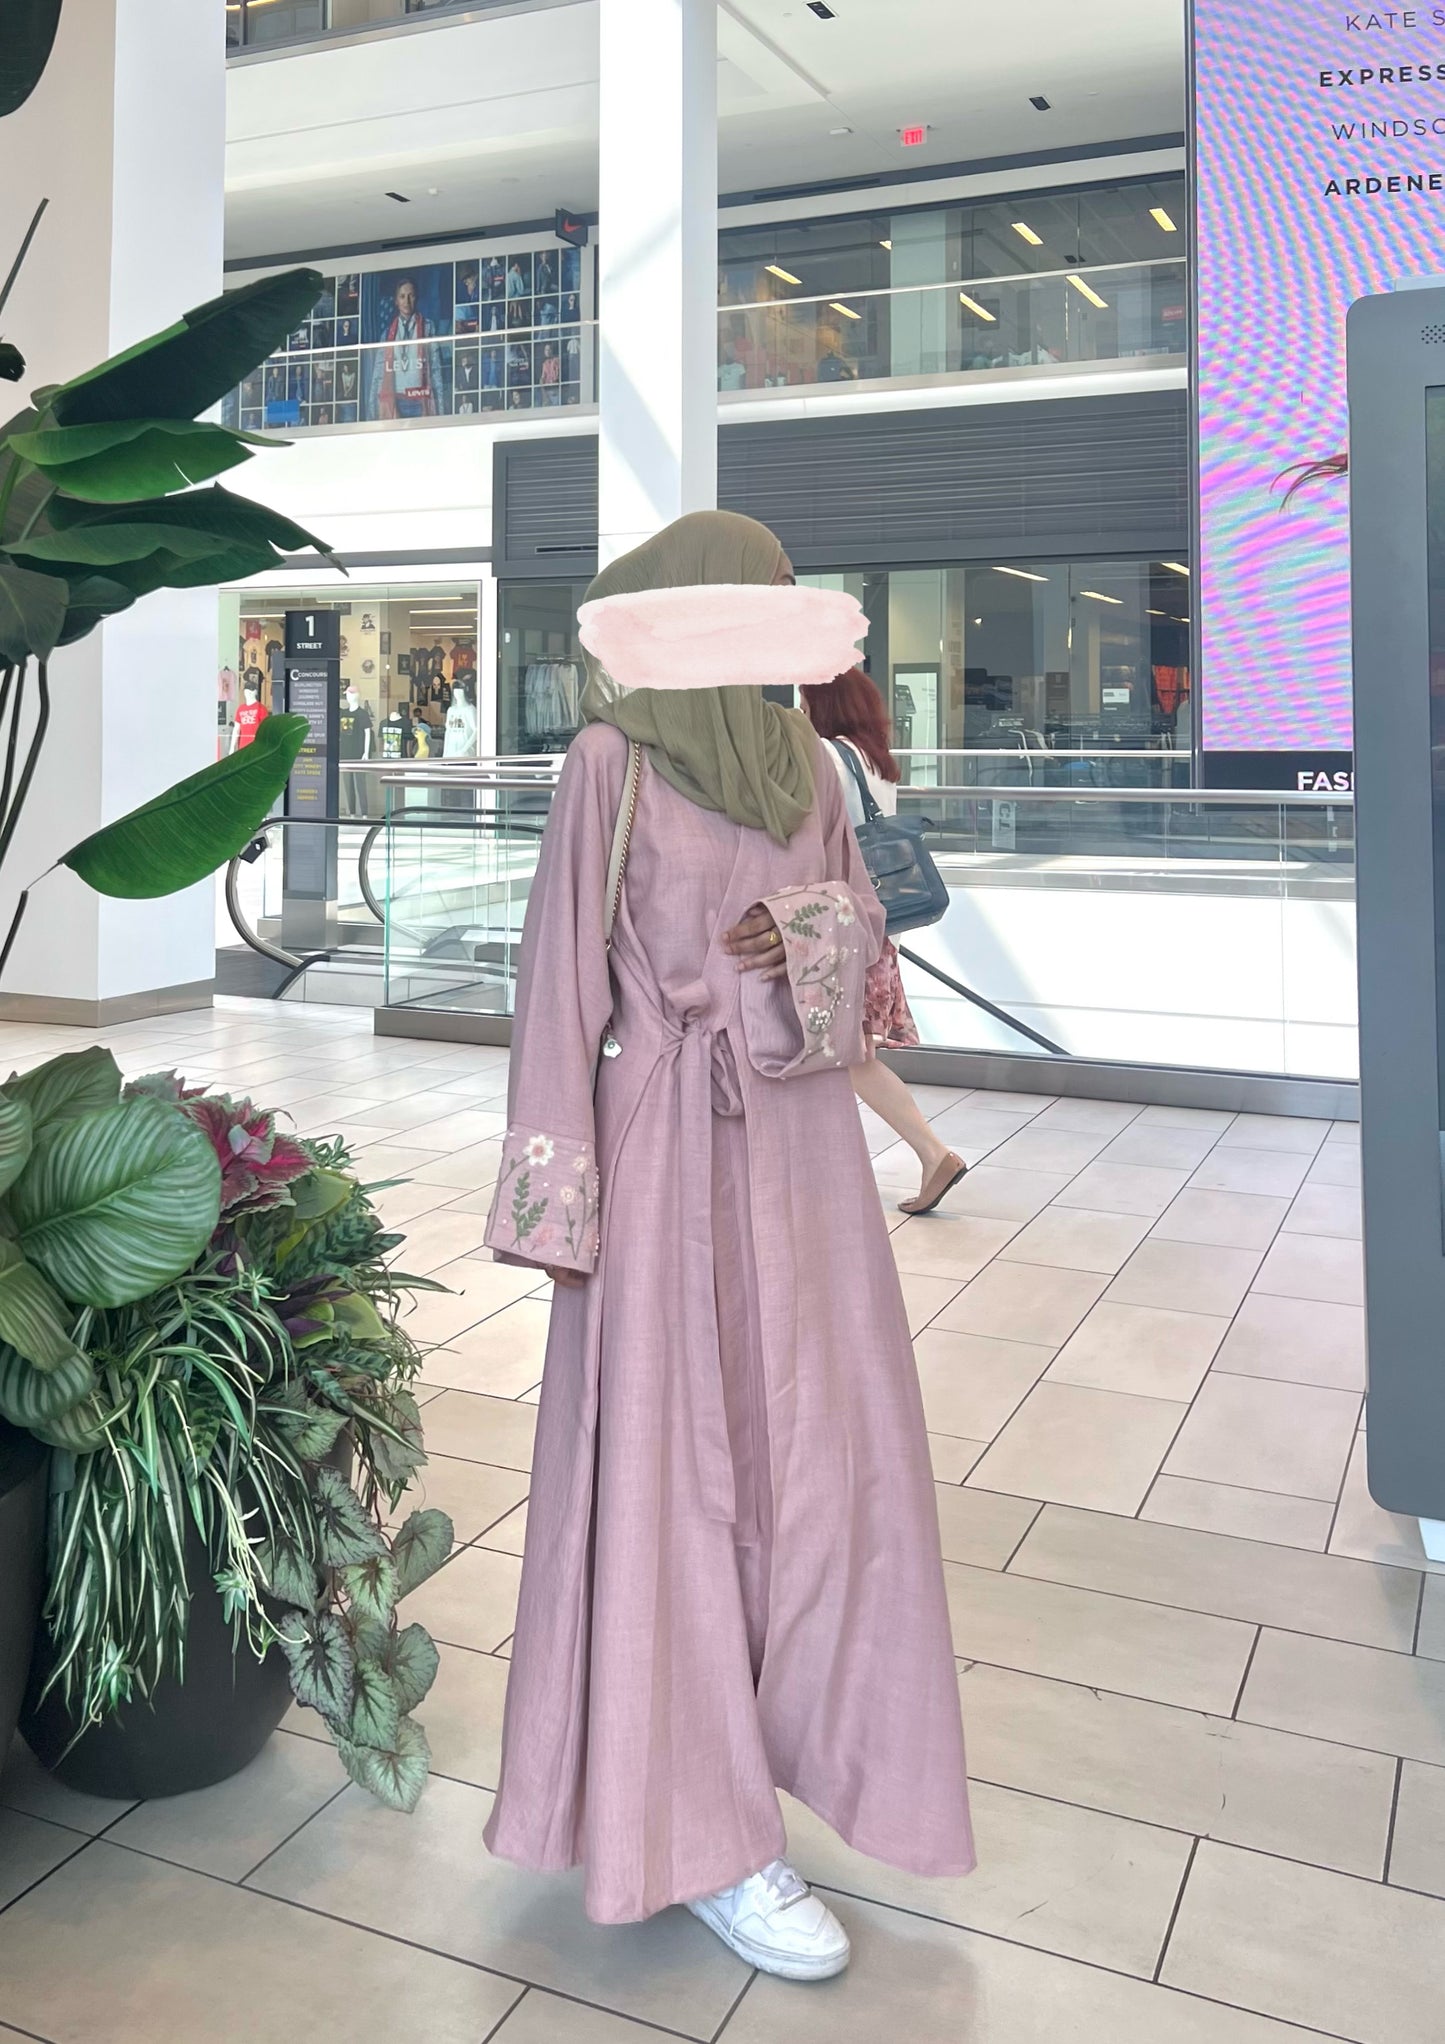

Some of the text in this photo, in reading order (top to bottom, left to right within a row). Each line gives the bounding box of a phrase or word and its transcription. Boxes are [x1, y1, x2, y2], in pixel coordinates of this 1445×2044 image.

[1346, 11, 1417, 31] KATE
[1319, 65, 1445, 87] EXPRESS
[1324, 174, 1443, 196] ARDENE
[305, 615, 315, 637] 1
[296, 642, 323, 650] STREET
[1297, 771, 1354, 791] FAS
